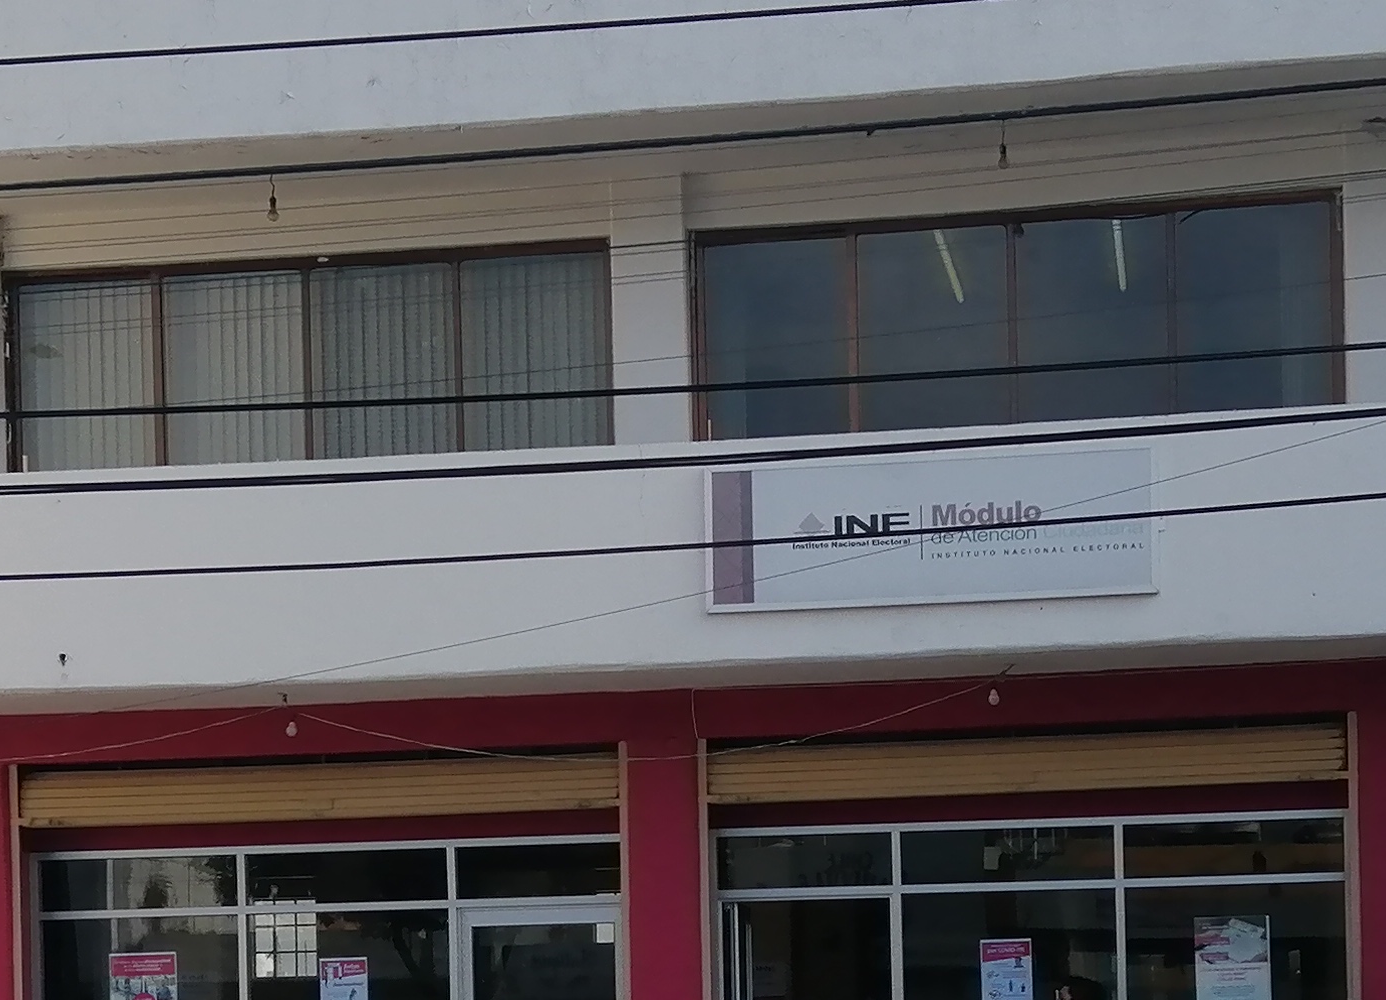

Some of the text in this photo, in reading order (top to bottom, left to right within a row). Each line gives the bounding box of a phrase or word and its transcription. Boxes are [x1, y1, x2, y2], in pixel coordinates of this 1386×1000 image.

[932, 500, 1042, 526] Módulo
[834, 512, 910, 537] INE
[792, 537, 911, 550] Instituto Nacional Electoral
[931, 542, 1145, 559] INSTITUTO NACIONAL ELECTORAL
